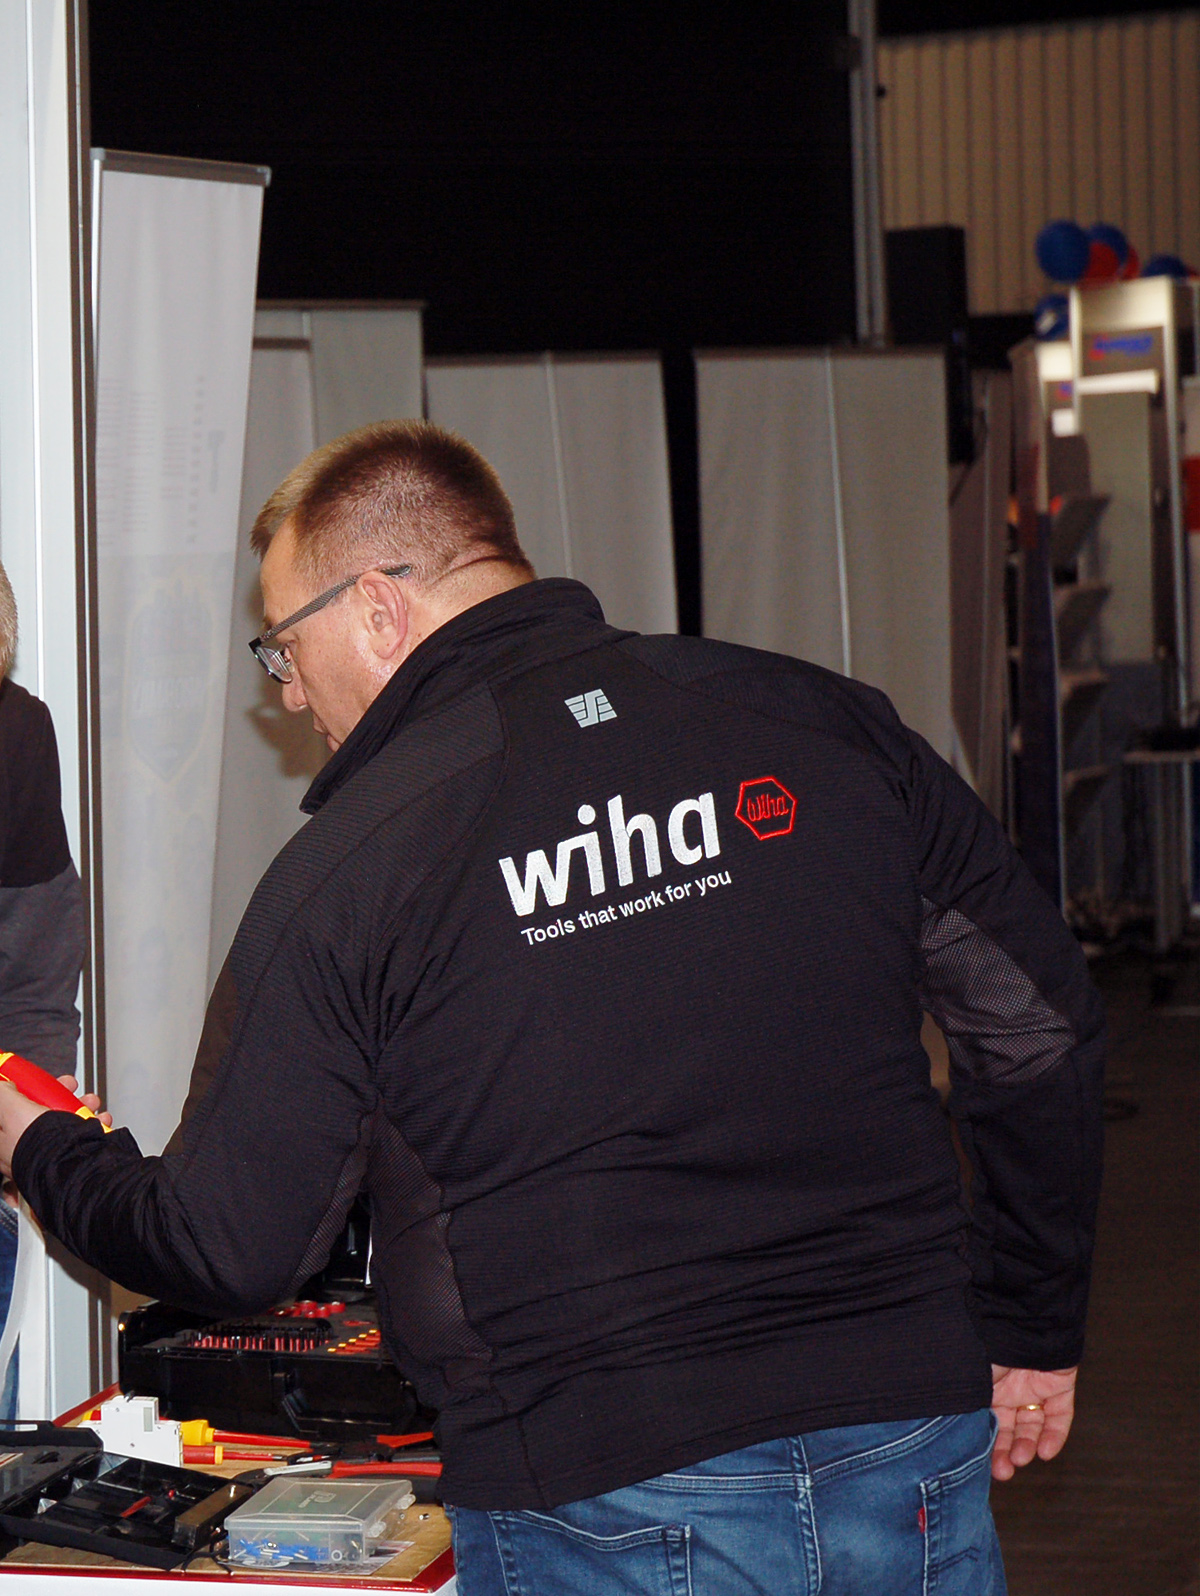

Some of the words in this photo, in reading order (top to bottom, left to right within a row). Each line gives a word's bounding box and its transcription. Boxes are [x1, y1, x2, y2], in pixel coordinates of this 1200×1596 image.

[499, 792, 721, 917] wiha
[521, 917, 576, 946] Tools
[577, 904, 618, 930] that
[618, 891, 666, 918] work
[665, 881, 692, 903] for
[695, 870, 733, 897] you
